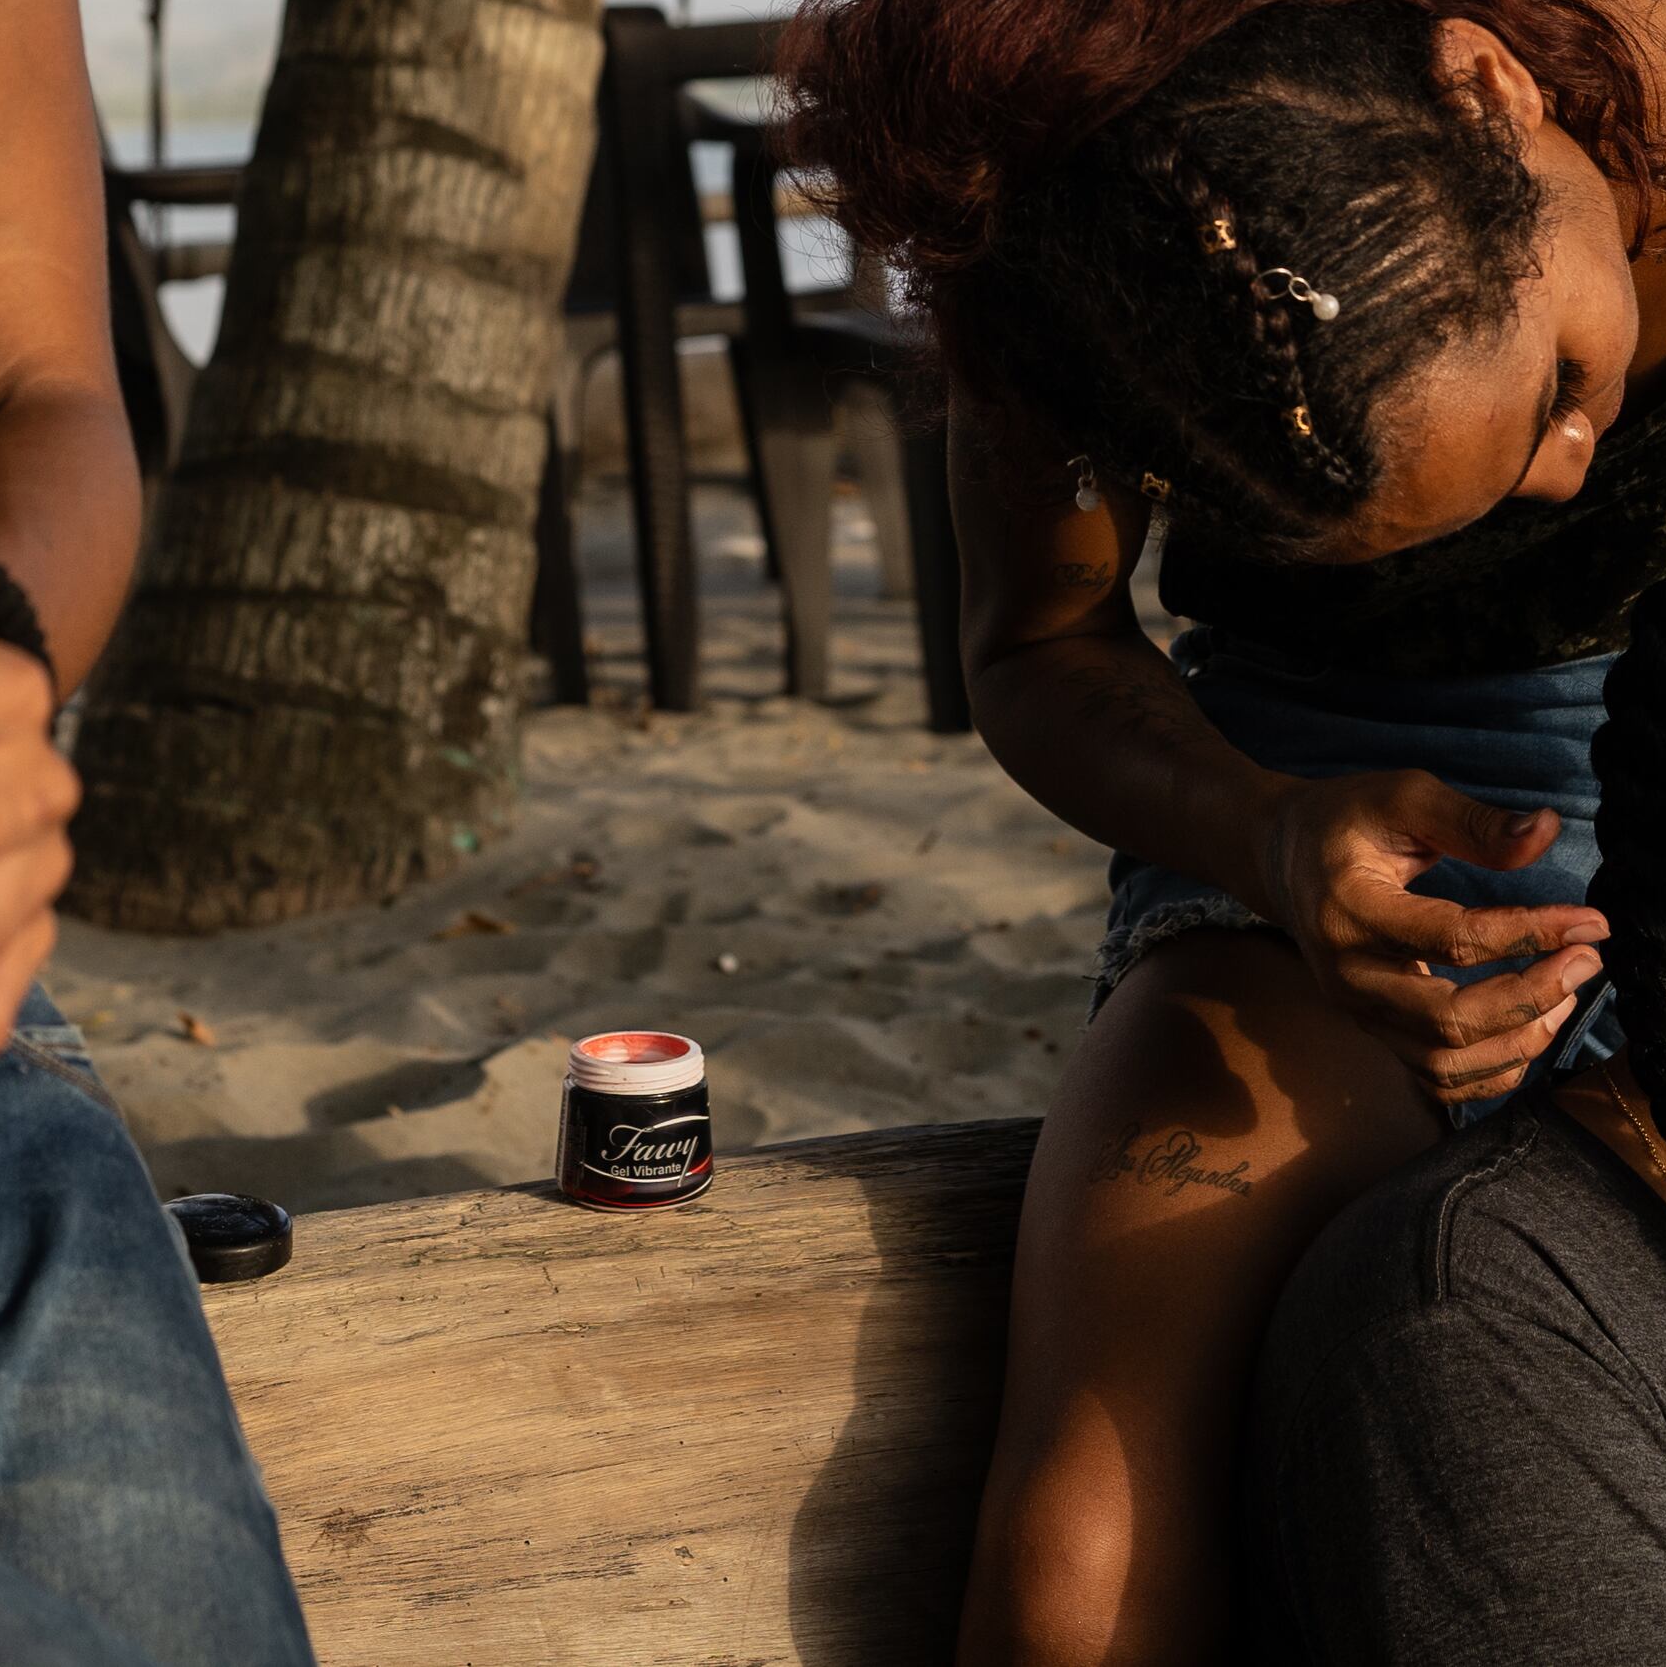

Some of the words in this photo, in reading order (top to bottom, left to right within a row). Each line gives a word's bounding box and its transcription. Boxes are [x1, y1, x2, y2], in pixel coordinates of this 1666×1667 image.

[601, 1124, 699, 1187] Fawy
[610, 1164, 630, 1177] Gel
[633, 1162, 682, 1177] Vibrante
